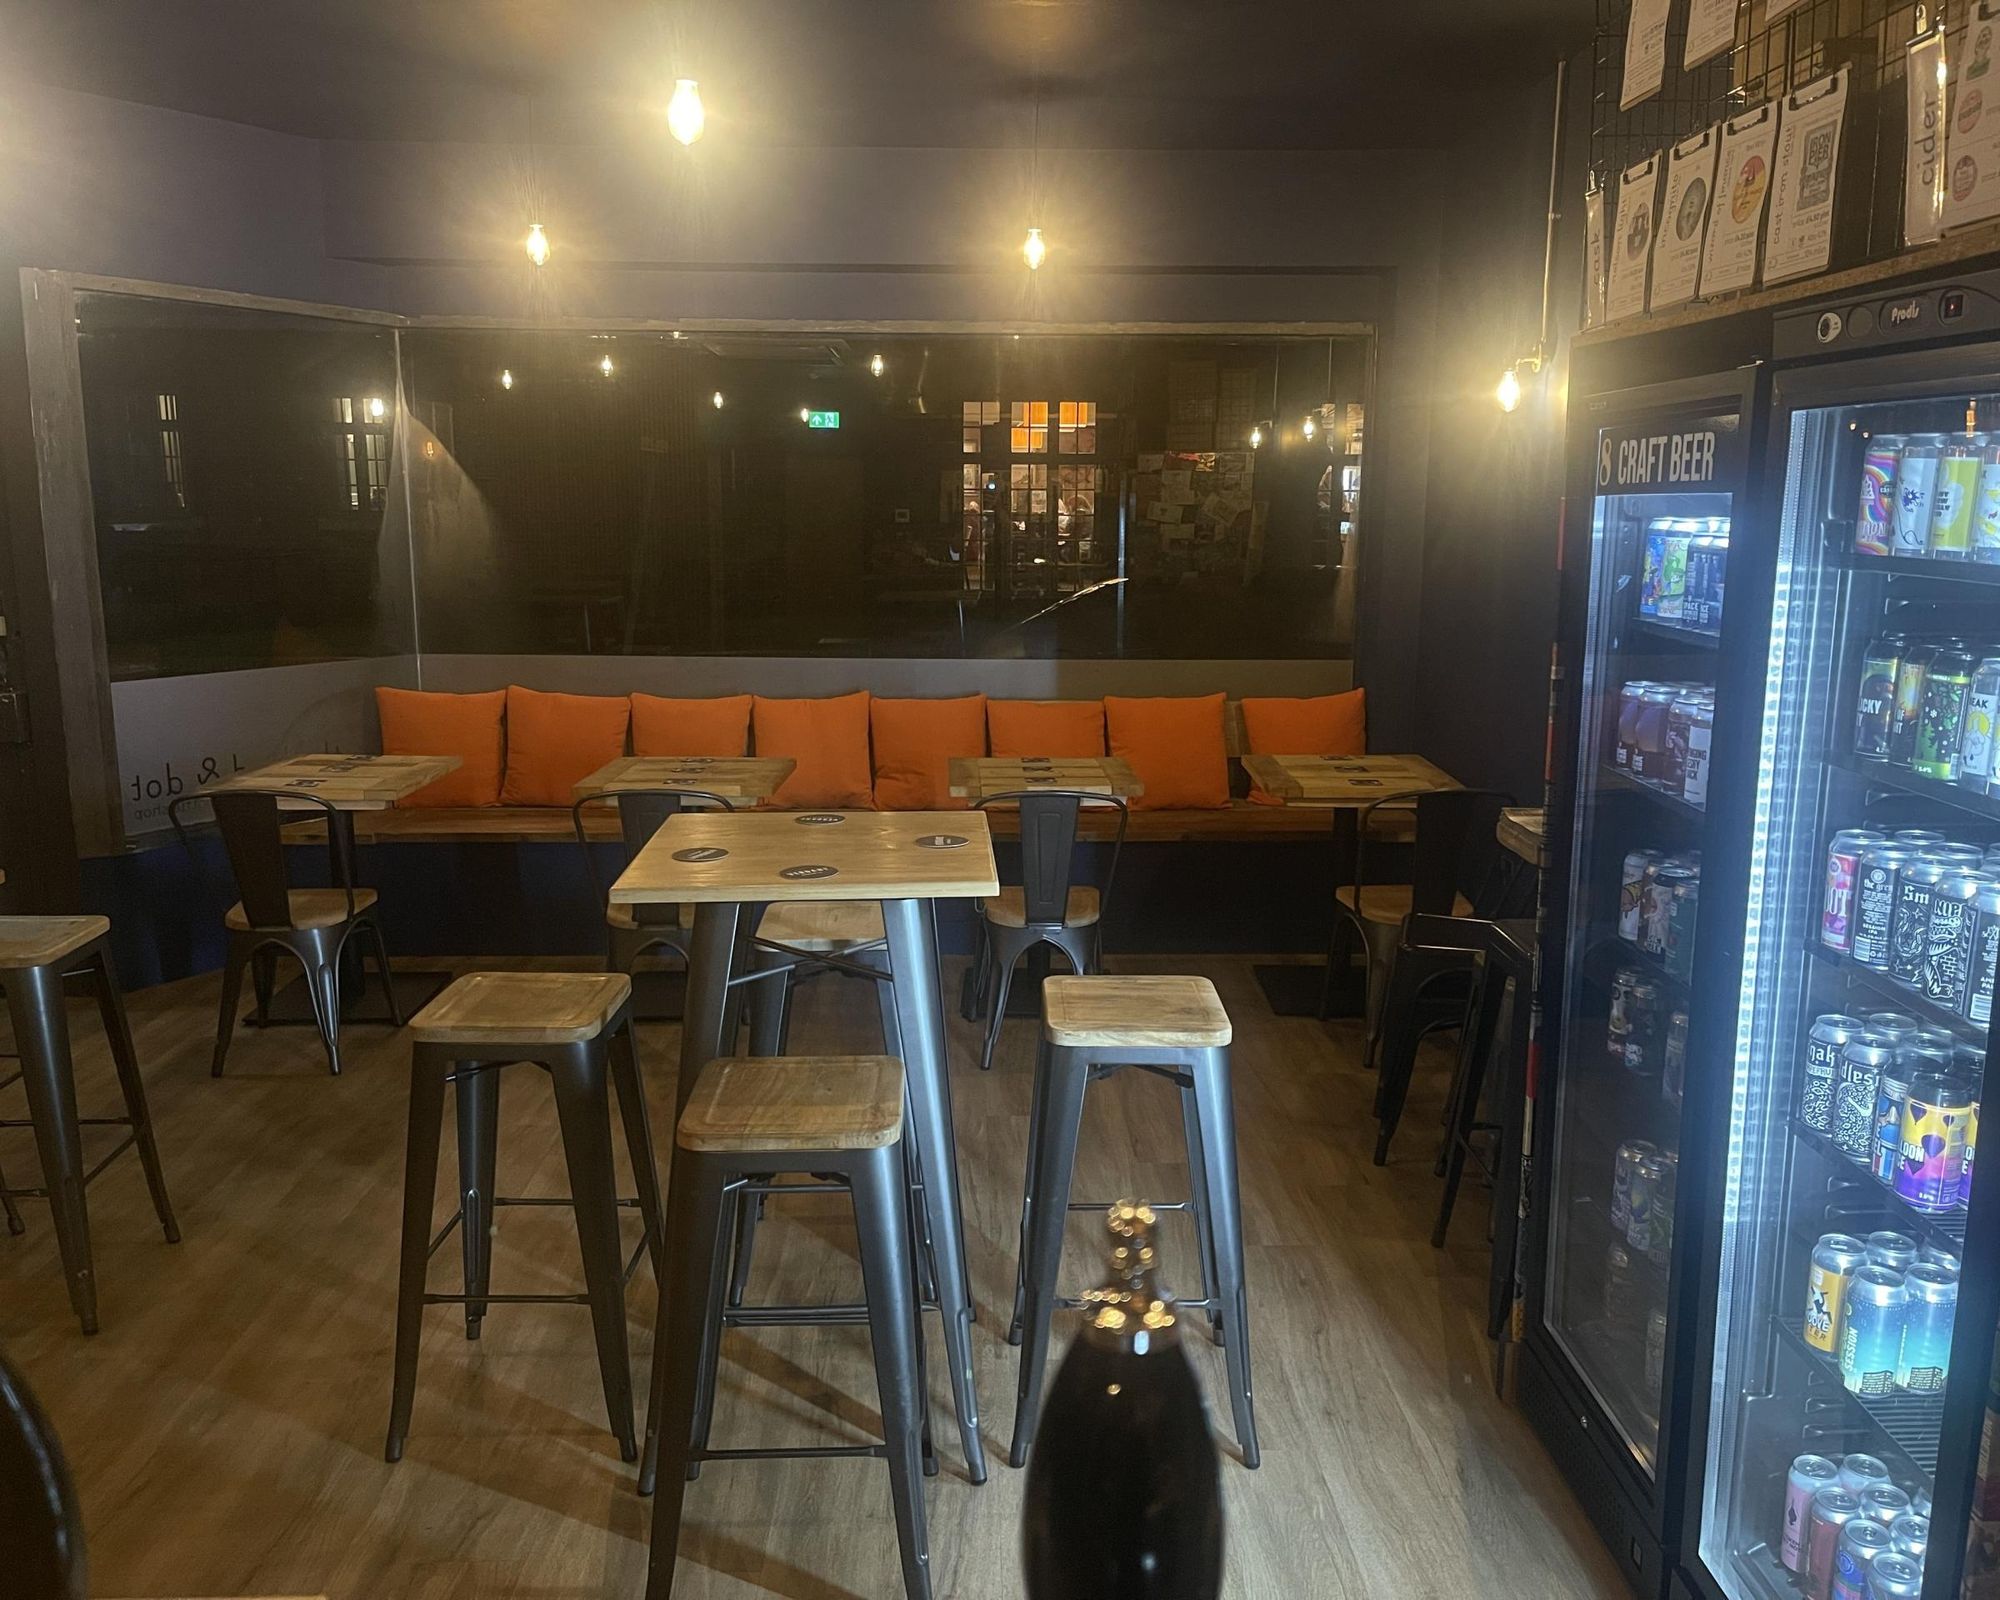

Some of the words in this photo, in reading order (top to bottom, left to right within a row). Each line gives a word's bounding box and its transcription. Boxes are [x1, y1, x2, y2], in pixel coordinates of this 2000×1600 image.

[1783, 126, 1794, 167] stout
[1914, 92, 1936, 186] cider
[1777, 173, 1788, 207] iron
[1773, 212, 1784, 245] cast
[1590, 229, 1601, 287] cask
[1617, 436, 1668, 485] CRAFT
[1669, 431, 1716, 483] BEER
[1845, 1326, 1858, 1373] SESSION
